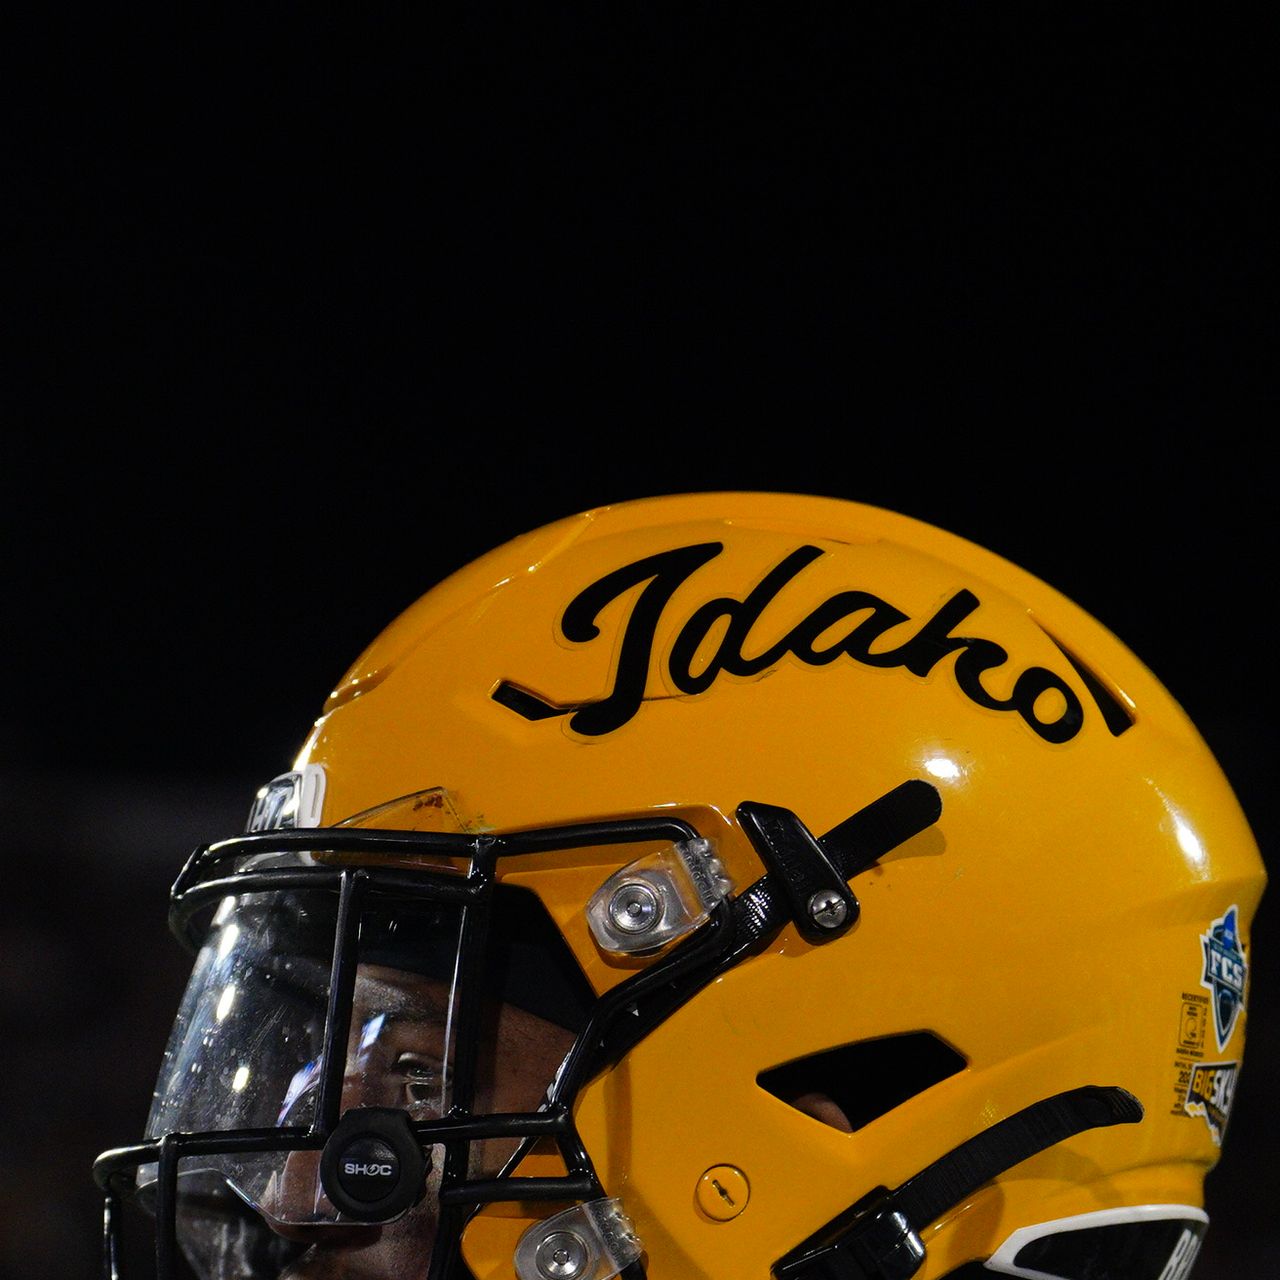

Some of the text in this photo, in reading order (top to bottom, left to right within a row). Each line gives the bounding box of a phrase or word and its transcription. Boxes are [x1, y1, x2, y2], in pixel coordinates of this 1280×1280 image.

[560, 541, 1085, 744] Idaho
[1210, 949, 1244, 990] FCS
[344, 1163, 393, 1176] SHOC
